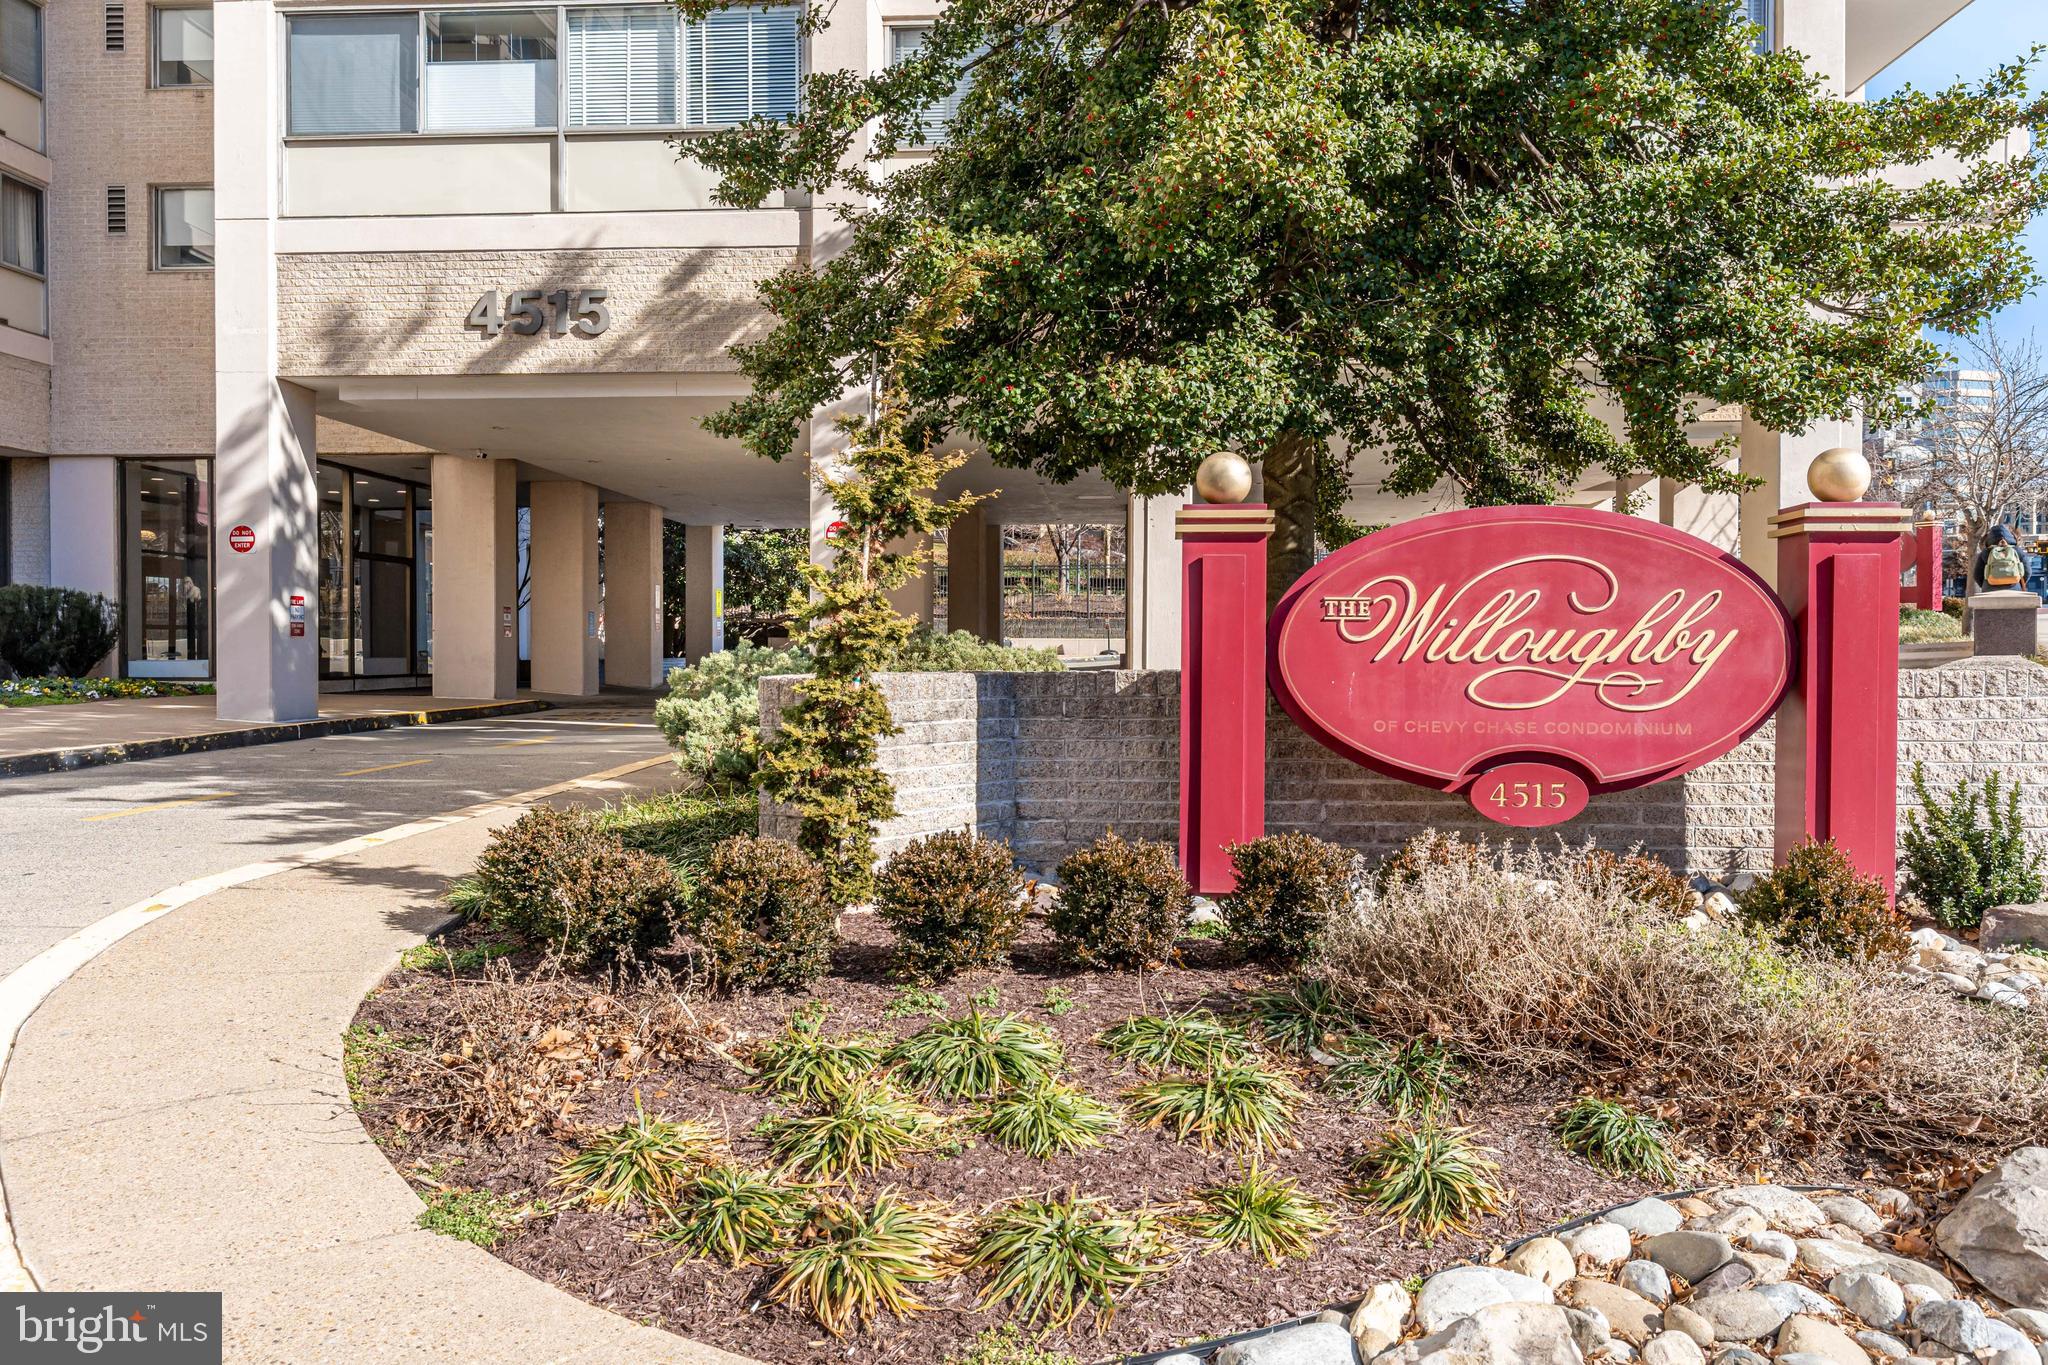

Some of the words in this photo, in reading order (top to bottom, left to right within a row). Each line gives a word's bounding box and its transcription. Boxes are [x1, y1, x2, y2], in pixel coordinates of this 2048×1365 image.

[470, 289, 610, 336] 4515
[1323, 598, 1371, 618] THE
[1338, 554, 1739, 712] Willoughby
[1373, 720, 1398, 733] OF
[1404, 720, 1468, 734] CHEVY
[1473, 721, 1537, 734] CHASE
[1544, 721, 1692, 735] CONDOMINIUM
[1489, 783, 1567, 808] 4515
